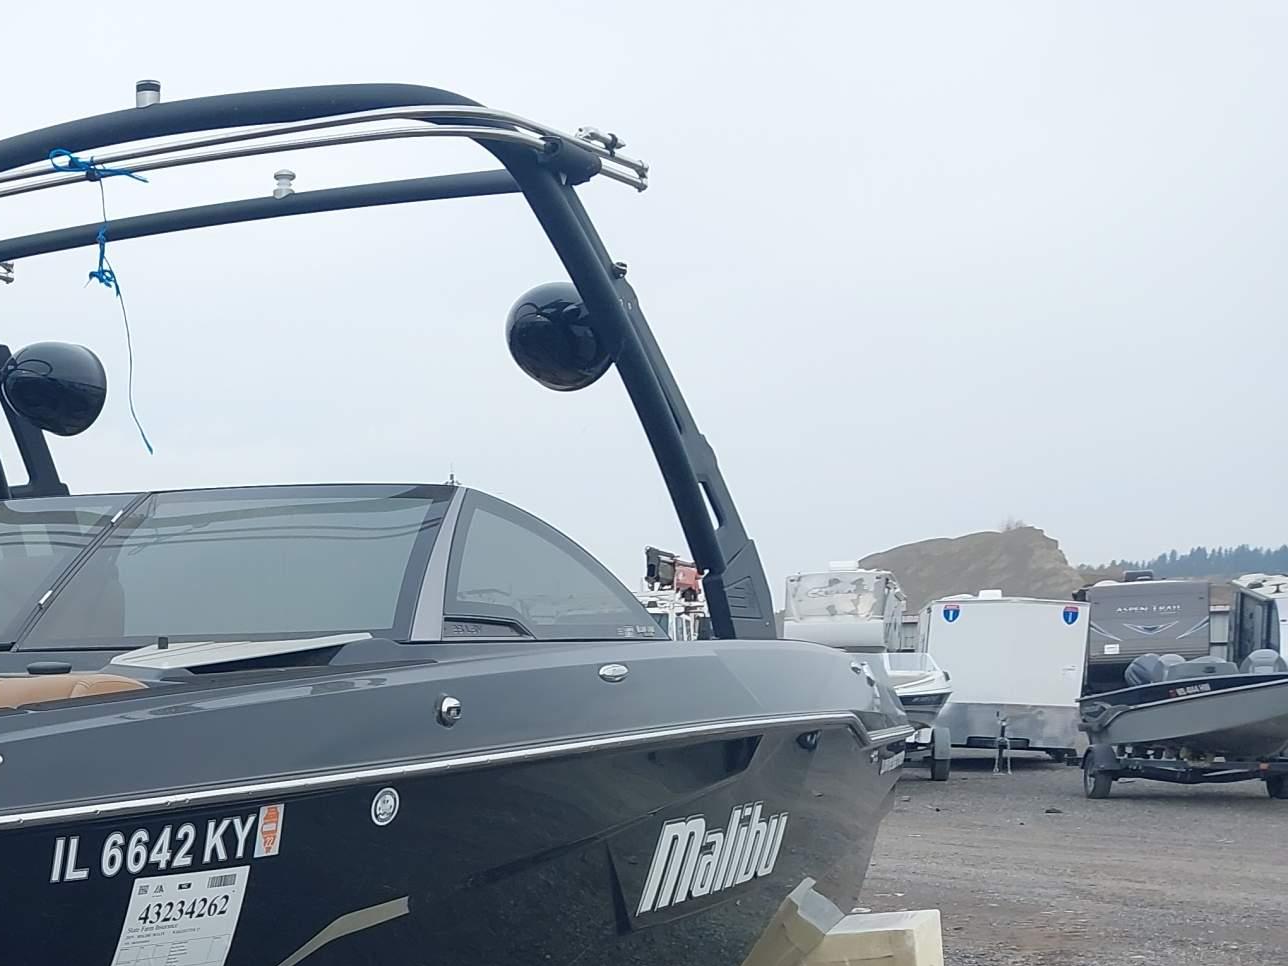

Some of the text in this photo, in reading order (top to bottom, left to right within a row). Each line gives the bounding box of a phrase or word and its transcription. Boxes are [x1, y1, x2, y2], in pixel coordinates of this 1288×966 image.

[50, 836, 90, 883] IL
[100, 822, 197, 878] 6642
[202, 813, 258, 864] KY
[636, 801, 789, 917] Malibu
[138, 894, 230, 925] 43234262
